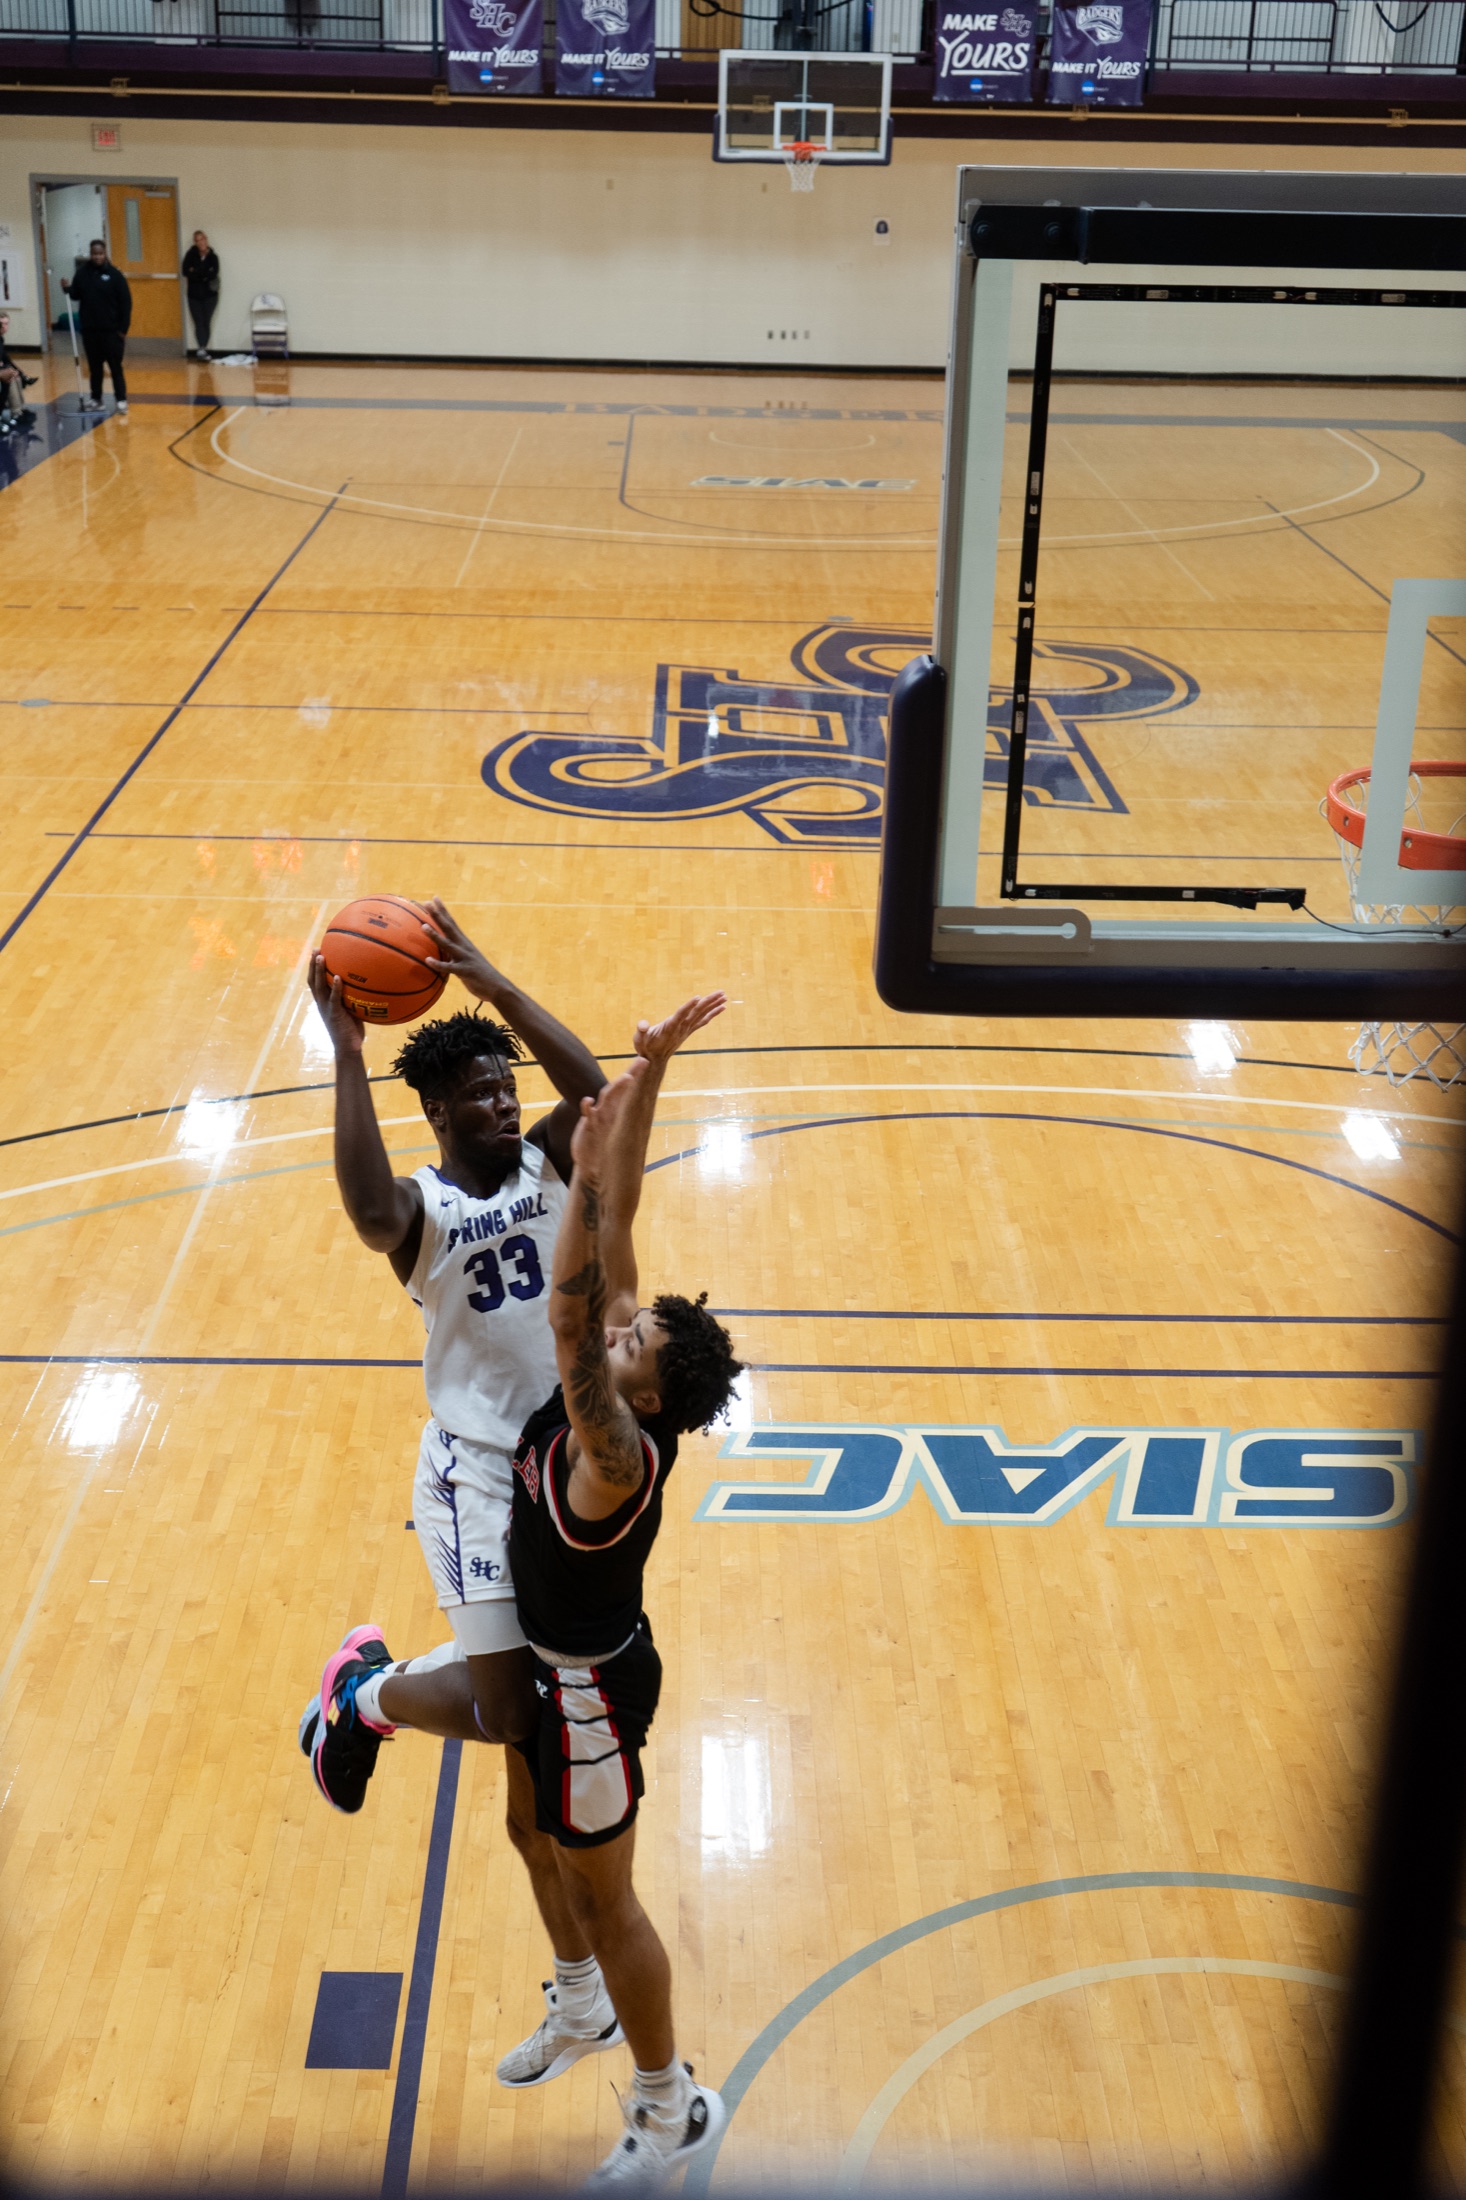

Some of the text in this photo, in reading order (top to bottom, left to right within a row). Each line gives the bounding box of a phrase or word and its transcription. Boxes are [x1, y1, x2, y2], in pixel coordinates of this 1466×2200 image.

[942, 14, 998, 31] MAKE
[448, 44, 539, 68] MAKE IT YOURS
[561, 47, 650, 70] MAKE IT YOURS
[938, 30, 1030, 78] YOURS
[1052, 56, 1141, 79] MAKE IT YOURS
[565, 403, 945, 421] BADGER
[690, 475, 918, 490] SIAC
[345, 994, 389, 1008] CHAMPIO
[351, 1002, 388, 1019] ELI
[509, 1192, 548, 1225] HILL
[463, 1233, 545, 1313] 33
[691, 1423, 1424, 1529] SIAC
[469, 1557, 500, 1581] SHC
